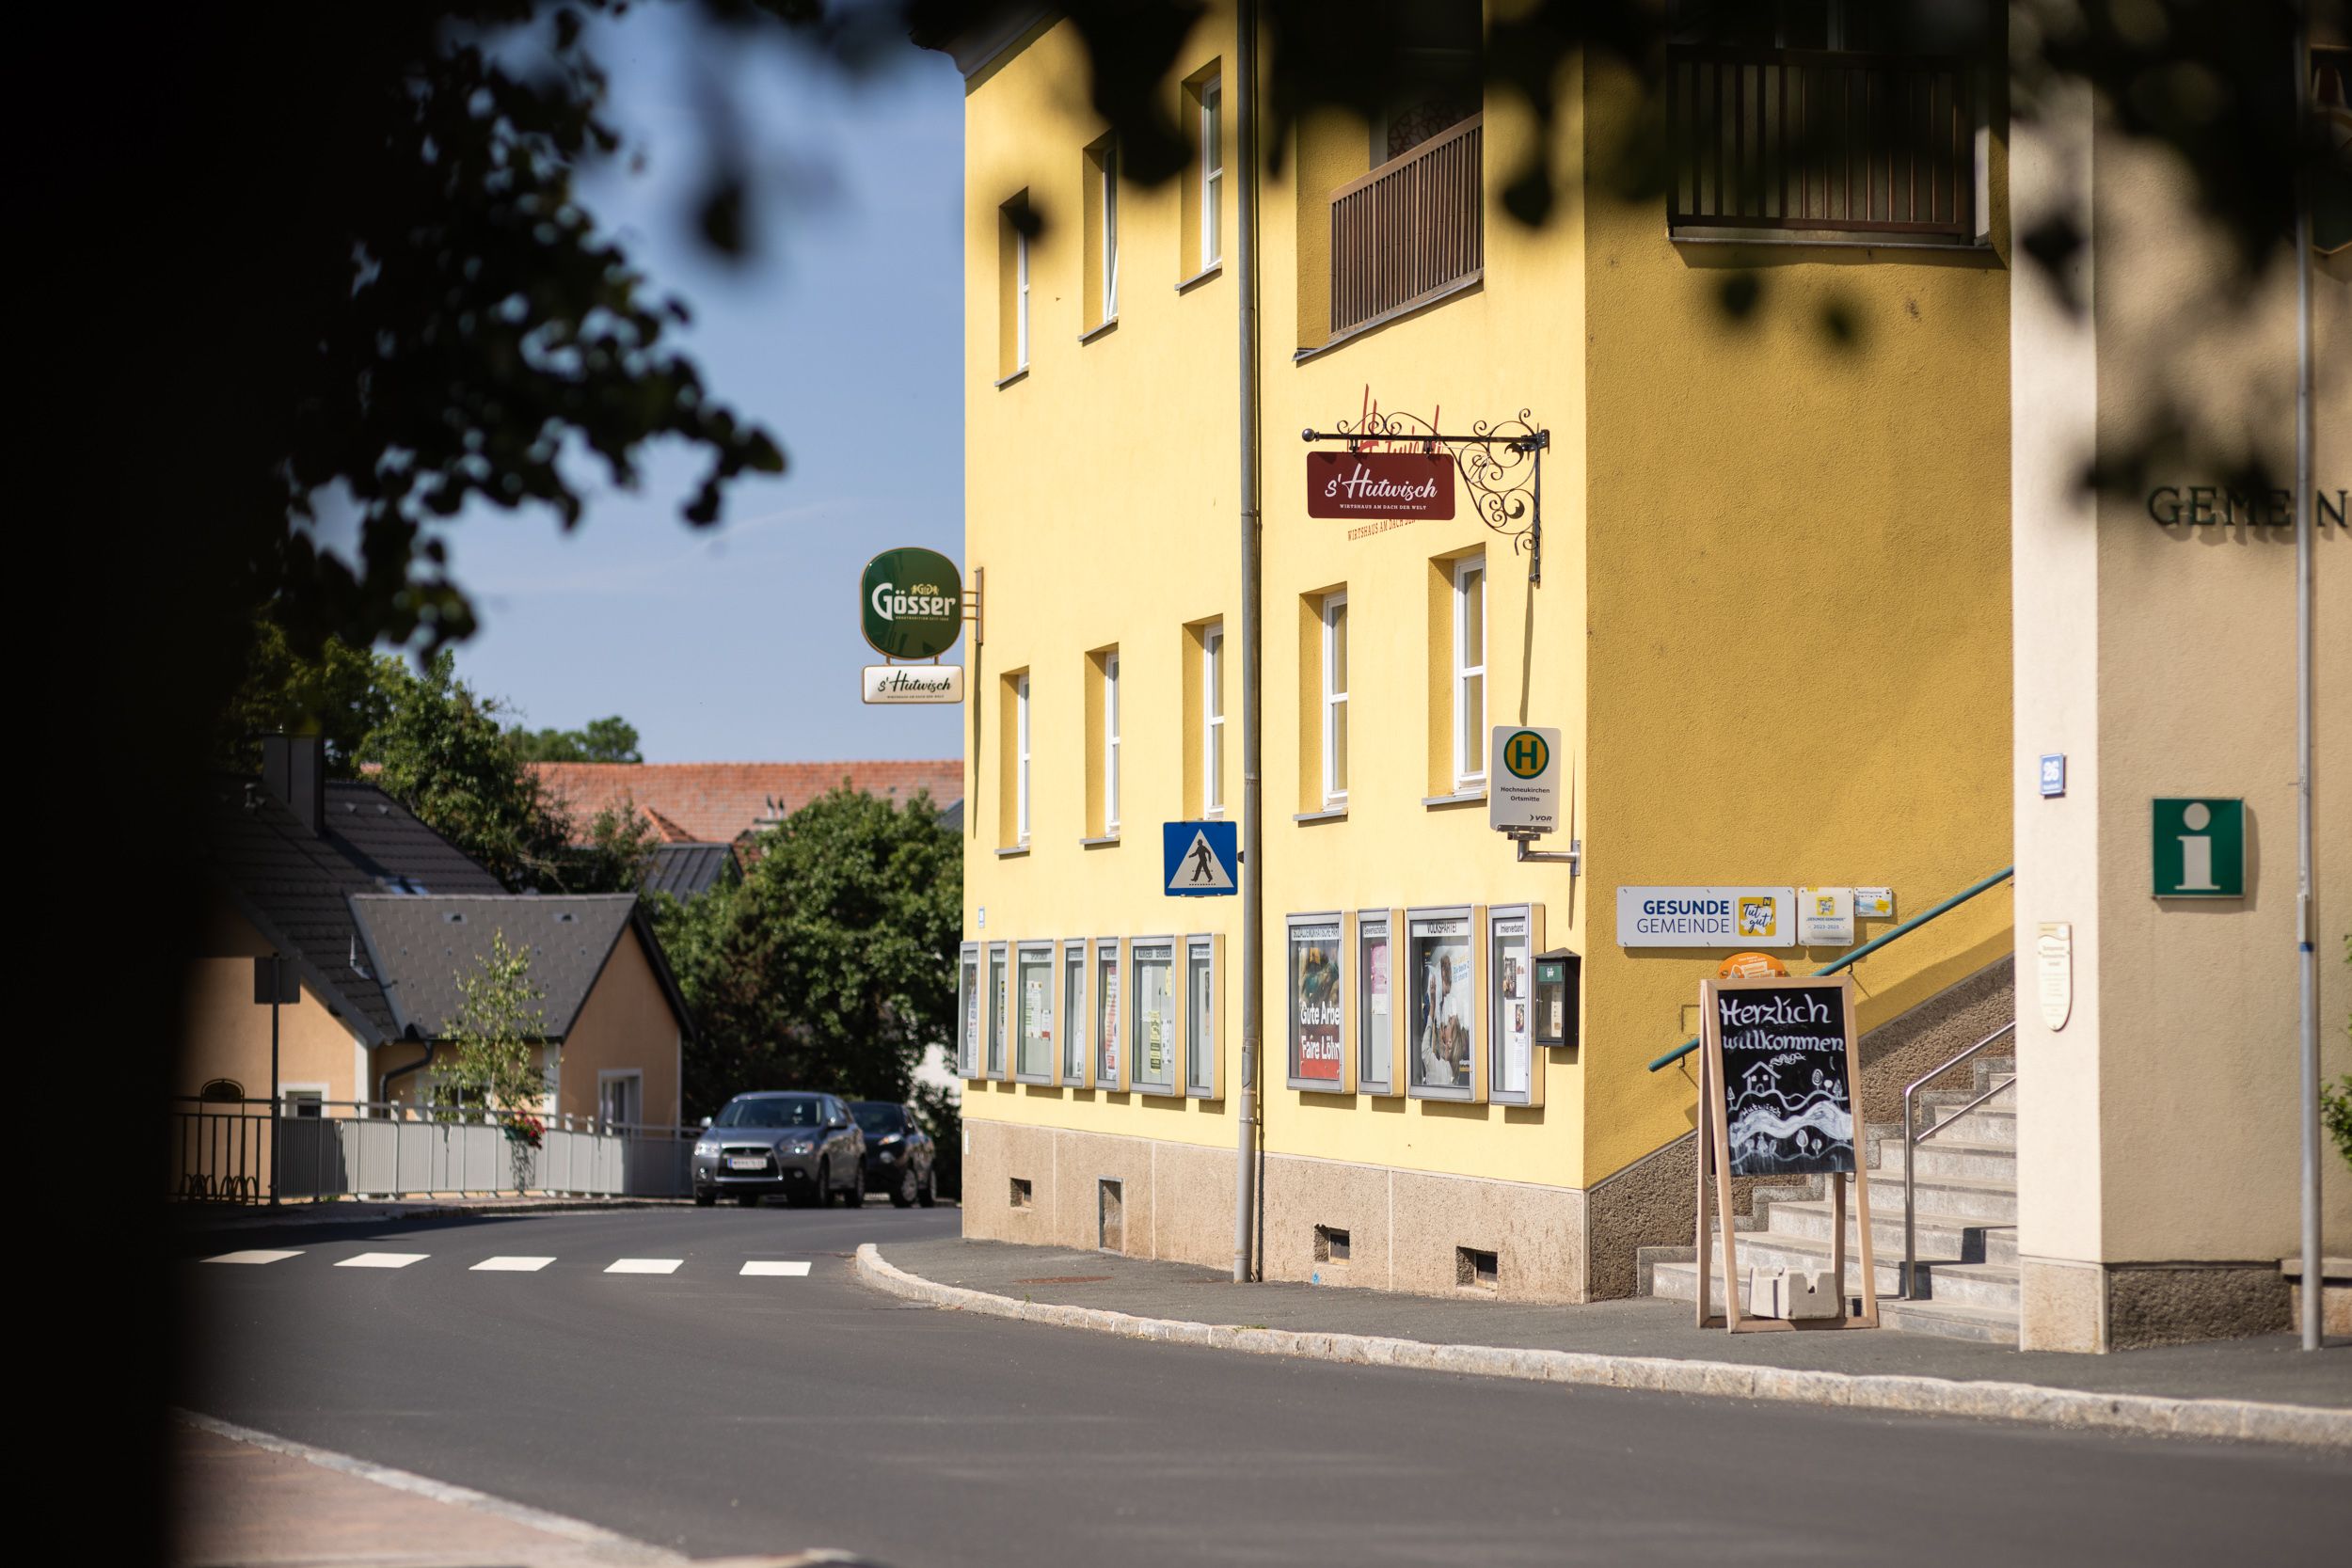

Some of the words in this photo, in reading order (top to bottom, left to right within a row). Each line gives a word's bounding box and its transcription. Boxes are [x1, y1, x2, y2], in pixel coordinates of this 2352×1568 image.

[2148, 485, 2348, 529] GEMEN
[1347, 523, 1378, 541] WIRTSHAUS
[1379, 519, 1389, 532] AM
[871, 582, 957, 621] Gösser
[1516, 740, 1537, 769] H
[1643, 900, 1730, 915] GESUNDE
[1743, 903, 1762, 918] Tut
[1636, 918, 1730, 934] GEMEINDE
[1748, 912, 1773, 934] gut!
[1300, 1001, 1320, 1025] Gute
[1720, 993, 1833, 1026] Herzlich
[1301, 1035, 1320, 1060] Faire
[1723, 1029, 1845, 1053] willkommen
